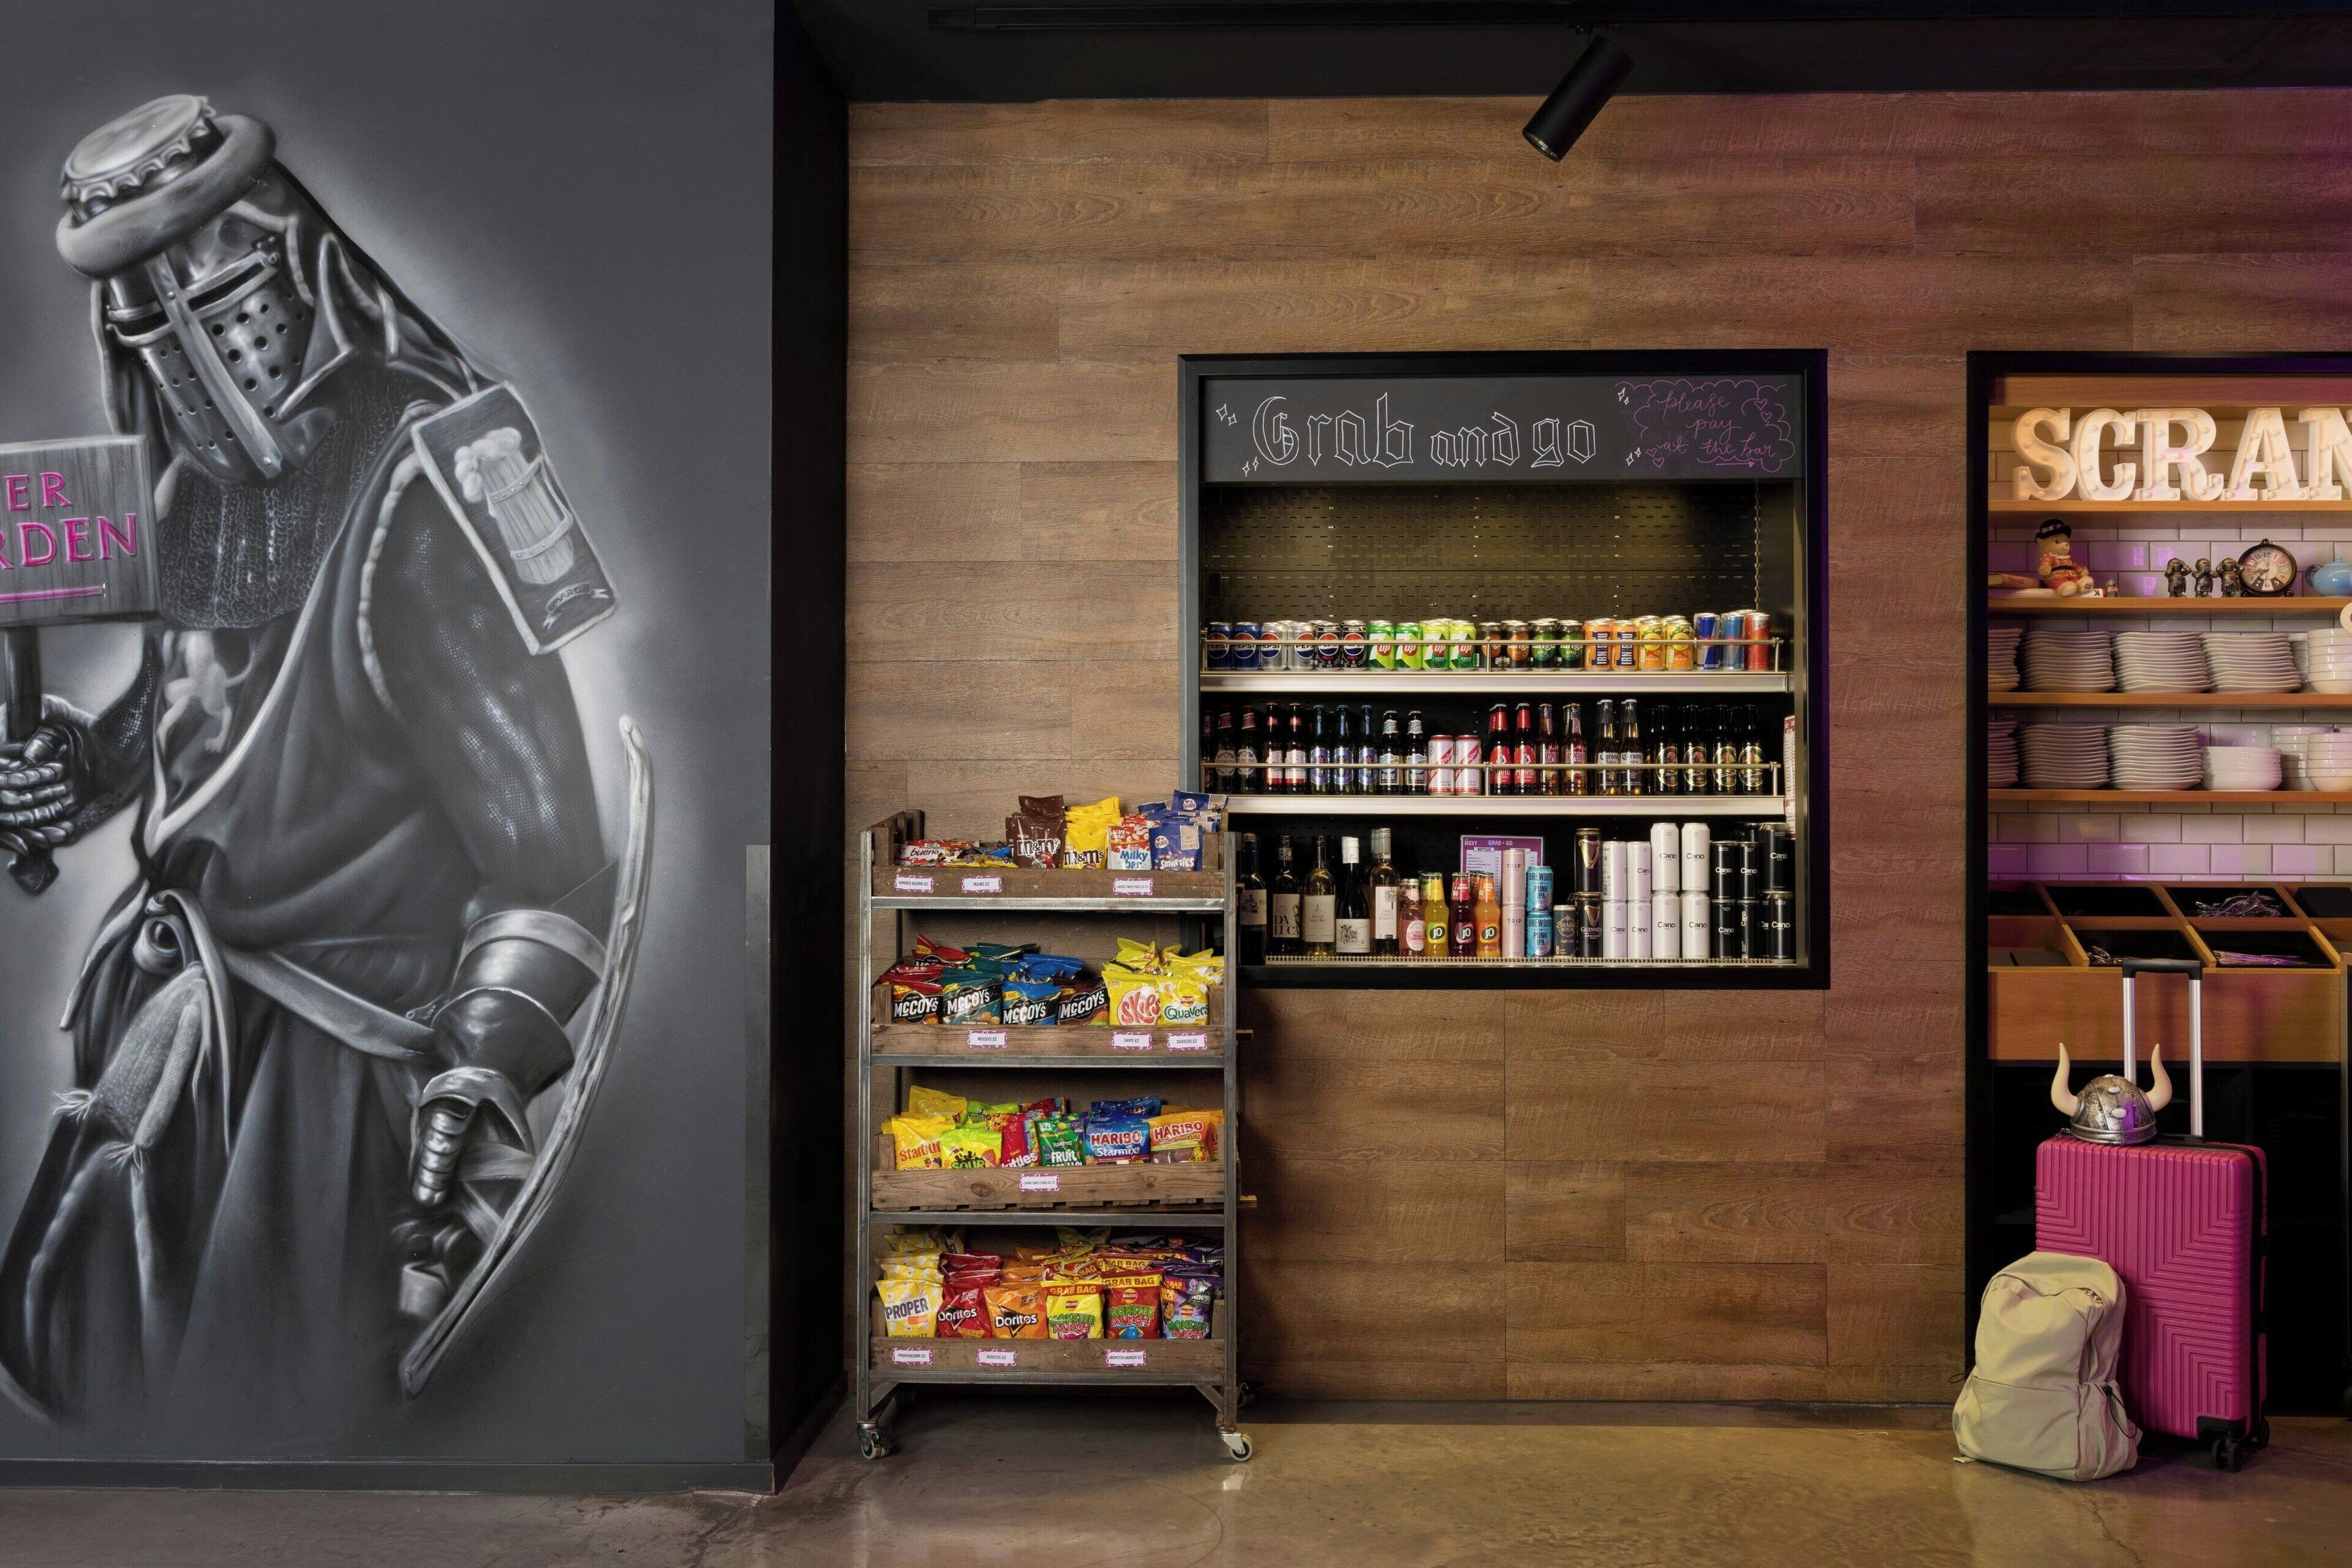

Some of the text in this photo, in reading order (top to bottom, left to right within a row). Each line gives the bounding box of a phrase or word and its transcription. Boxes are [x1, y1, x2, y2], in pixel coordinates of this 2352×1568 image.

[1657, 390, 1731, 419] please
[1253, 392, 1596, 468] Grab and go
[1686, 419, 1742, 445] pay
[1657, 432, 1776, 457] at the bar
[910, 847, 939, 856] bueno
[1120, 850, 1148, 861] Milky
[1164, 1004, 1209, 1020] Quavers
[1154, 1121, 1204, 1140] HARIBO
[1091, 1130, 1142, 1146] HARIBO
[1051, 1150, 1077, 1163] FRUIT
[1095, 1147, 1137, 1156] Starmix
[1079, 1264, 1097, 1276] BAG
[1104, 1278, 1131, 1286] GRAB
[1050, 1287, 1074, 1295] GRAB
[885, 1297, 929, 1319] PROPER
[938, 1307, 977, 1322] Doritos
[1107, 1305, 1155, 1317] MONSTER
[995, 1313, 1038, 1328] Doritos
[1049, 1313, 1095, 1327] MONSTER
[1112, 1316, 1152, 1327] MUNCH
[1166, 1320, 1208, 1330] MONSTER
[1053, 1324, 1091, 1333] MUNCH
[1171, 1329, 1205, 1338] MUNCH
